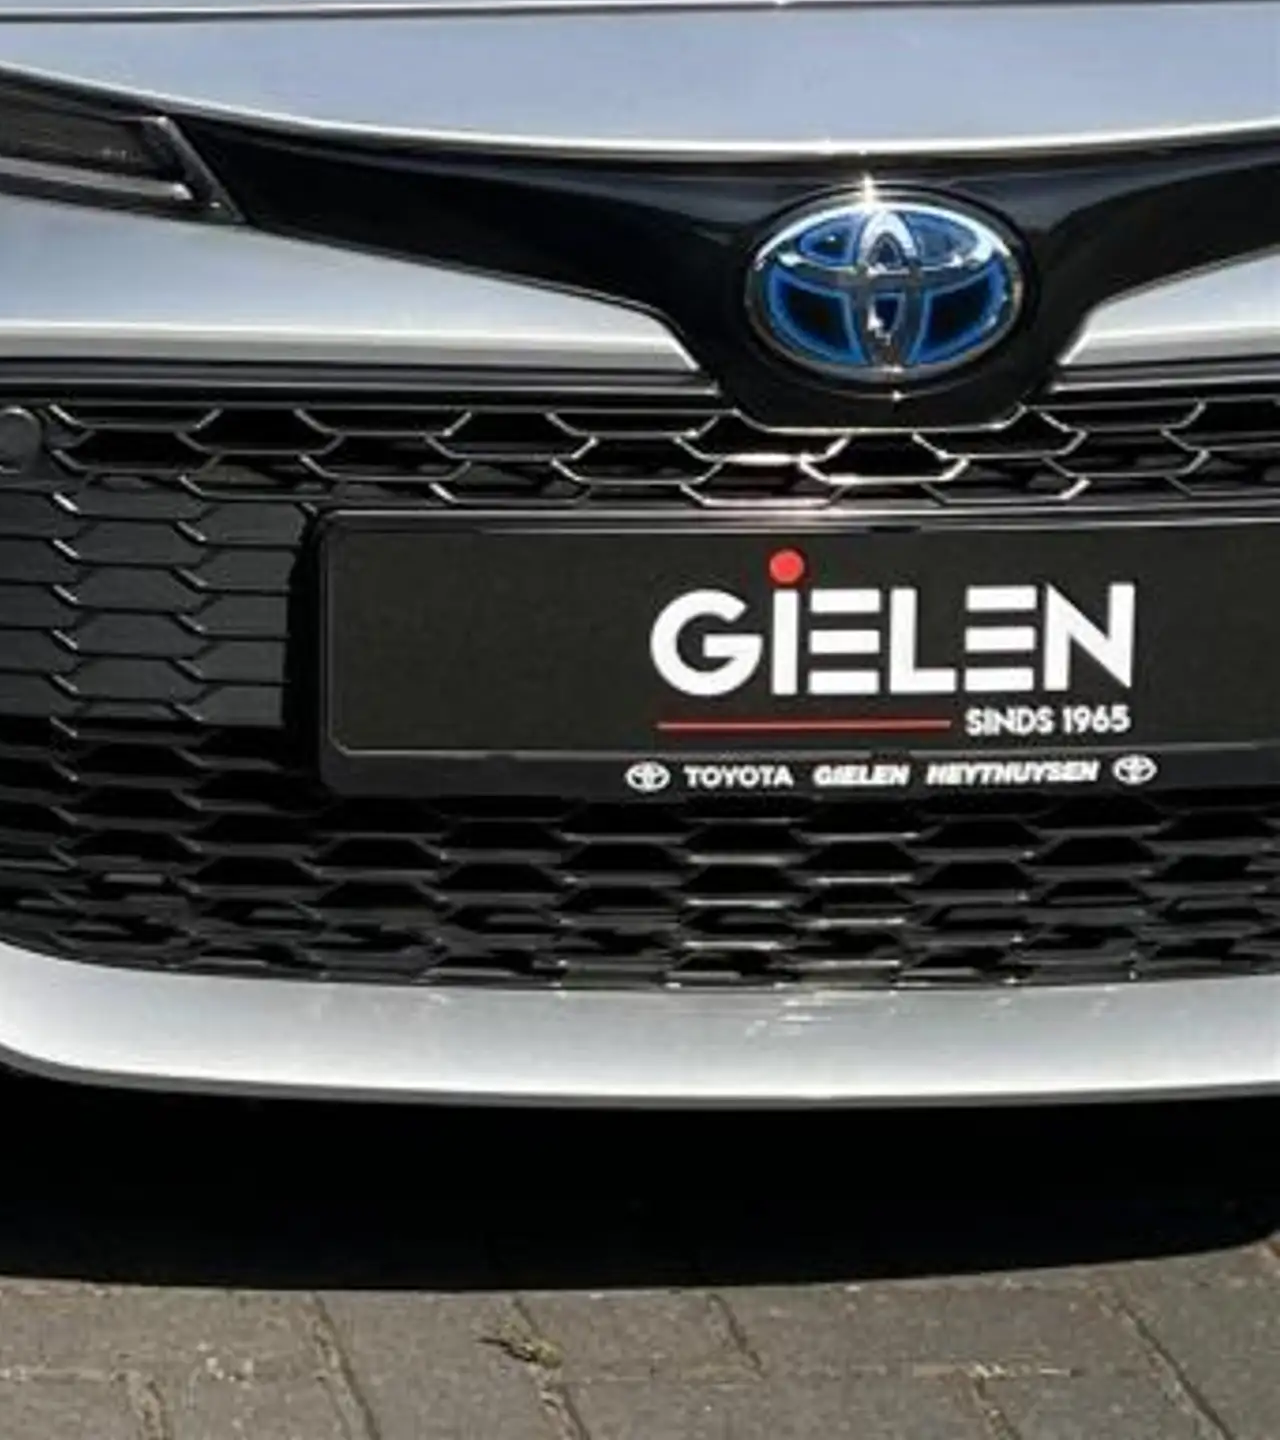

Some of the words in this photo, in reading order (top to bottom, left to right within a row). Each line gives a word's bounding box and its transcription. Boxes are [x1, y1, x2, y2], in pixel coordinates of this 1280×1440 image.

[964, 706, 1055, 737] SINDS
[1061, 703, 1132, 734] 1965
[683, 763, 794, 789] TOYOTA
[812, 763, 911, 787] GIELEN
[926, 760, 1101, 786] HEYTHUYSEN
